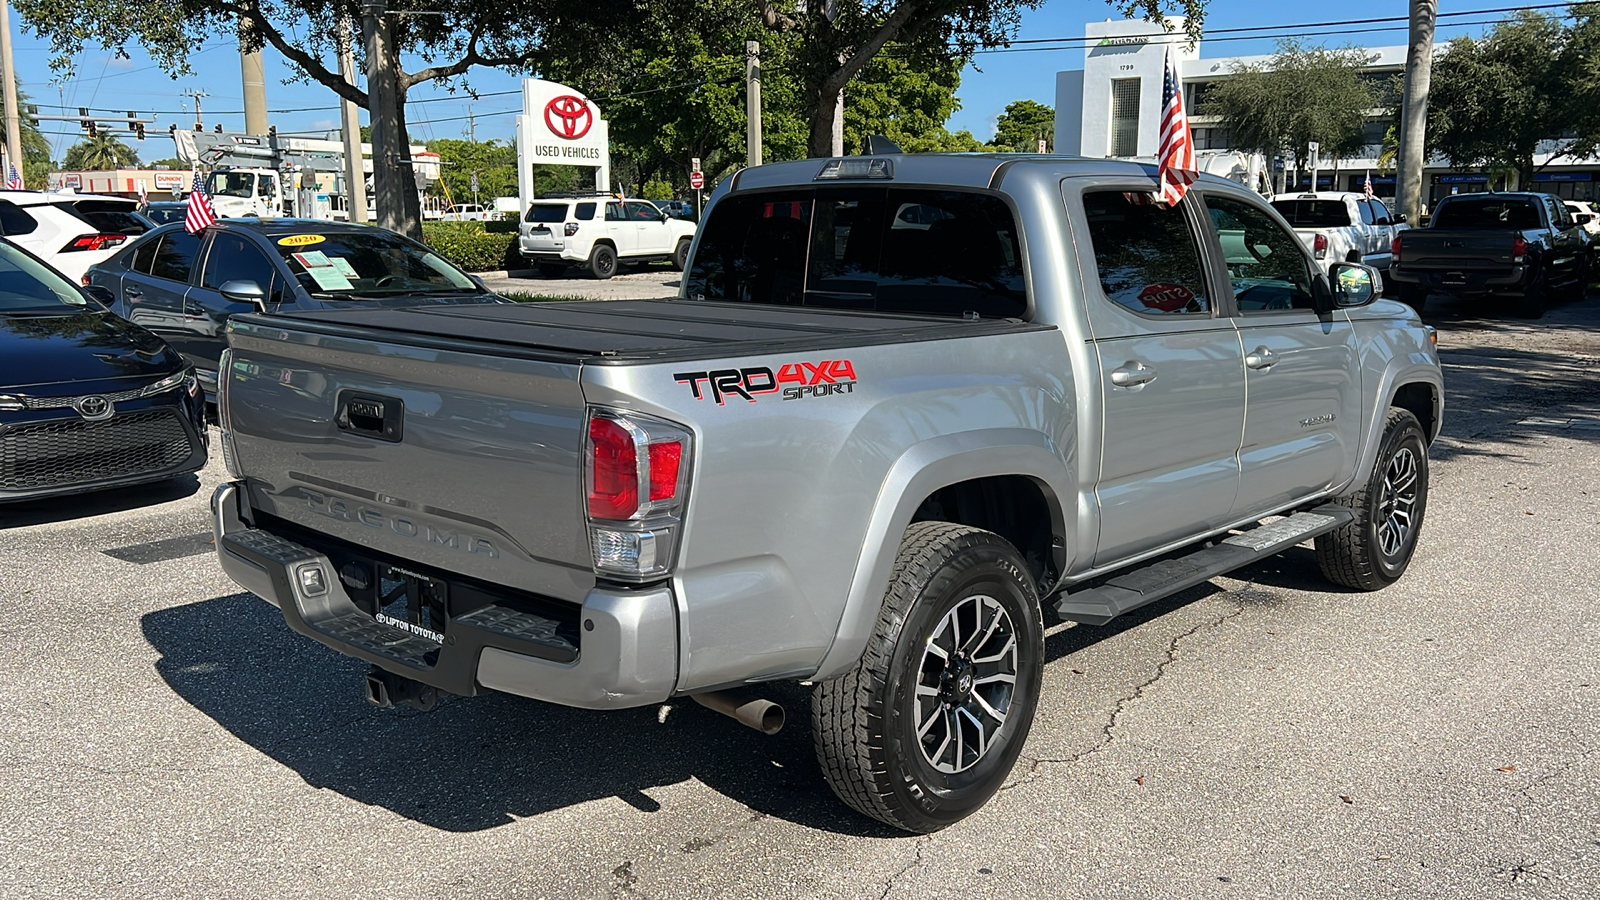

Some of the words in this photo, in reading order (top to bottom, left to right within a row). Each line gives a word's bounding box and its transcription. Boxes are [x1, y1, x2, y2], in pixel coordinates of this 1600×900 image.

[535, 145, 560, 157] USED
[561, 146, 600, 159] VEHICLES
[287, 235, 317, 245] 2020
[673, 366, 779, 406] TRD
[782, 381, 858, 401] SPORT
[351, 402, 380, 417] TOYOTA
[299, 487, 500, 558] TACOMA
[385, 615, 410, 632] LIPTON
[409, 624, 437, 641] TOYOTA
